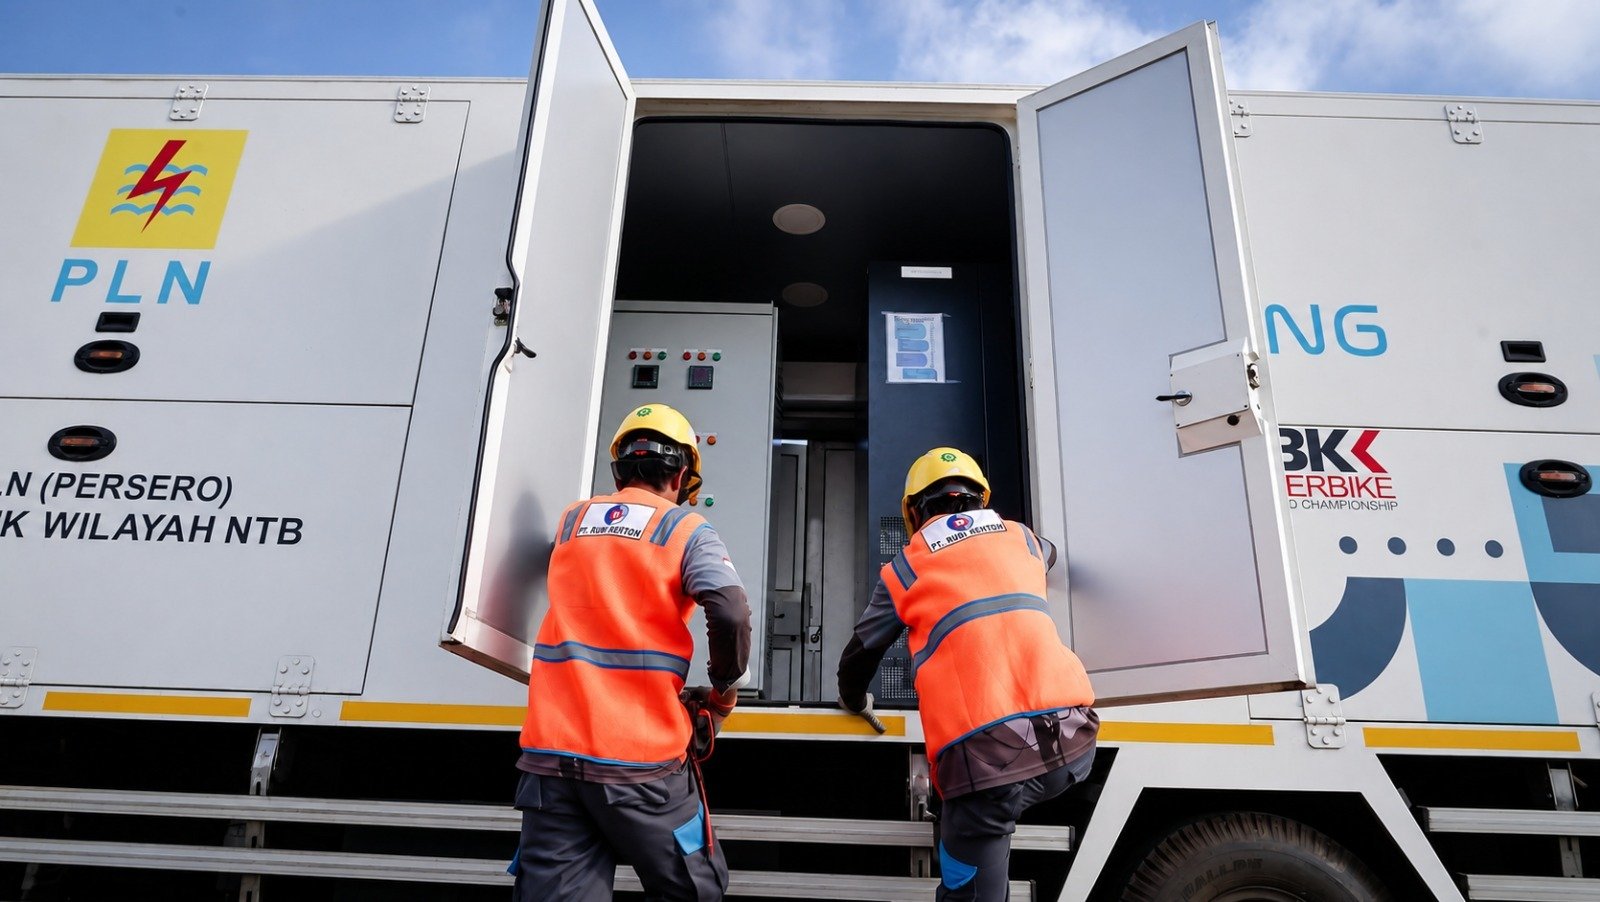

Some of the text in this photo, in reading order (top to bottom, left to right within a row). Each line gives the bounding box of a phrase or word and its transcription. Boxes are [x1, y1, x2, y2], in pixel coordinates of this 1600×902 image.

[51, 259, 211, 304] PLN
[1265, 304, 1387, 356] NG
[0, 472, 232, 508] N (PERSERO)
[1286, 475, 1396, 499] ERBIKE
[1302, 499, 1398, 511] CHAMPIONSHIP
[0, 510, 303, 545] K WILAYAH NTB
